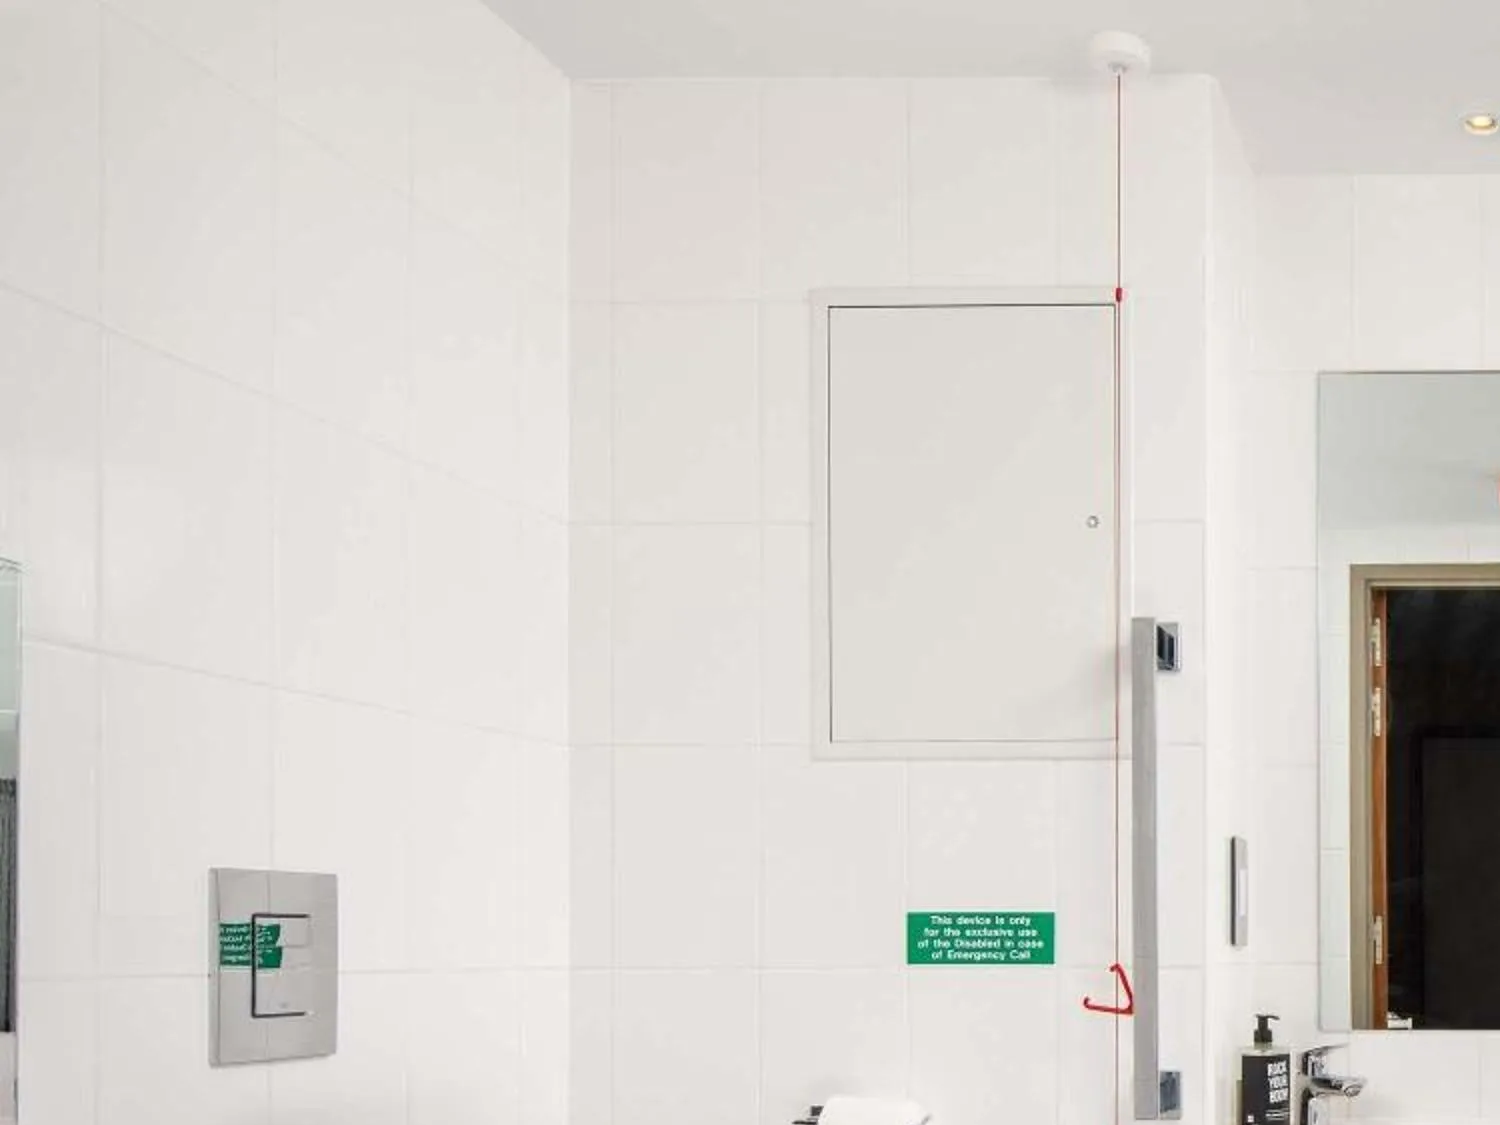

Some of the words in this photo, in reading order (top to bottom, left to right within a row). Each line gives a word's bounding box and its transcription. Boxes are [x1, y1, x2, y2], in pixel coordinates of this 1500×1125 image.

[930, 915, 952, 925] This
[956, 915, 991, 925] device
[995, 915, 1004, 925] is
[1009, 916, 1031, 926] only
[924, 927, 939, 937] for
[944, 927, 960, 937] the
[965, 927, 1014, 937] exclusive
[1018, 929, 1038, 937] use
[917, 939, 928, 949] of
[933, 939, 950, 949] the
[954, 939, 1000, 949] Disabled
[1004, 939, 1014, 949] in
[1018, 941, 1044, 949] case
[931, 950, 943, 960] of
[947, 950, 1006, 962] Emergency
[1009, 950, 1031, 960] Call
